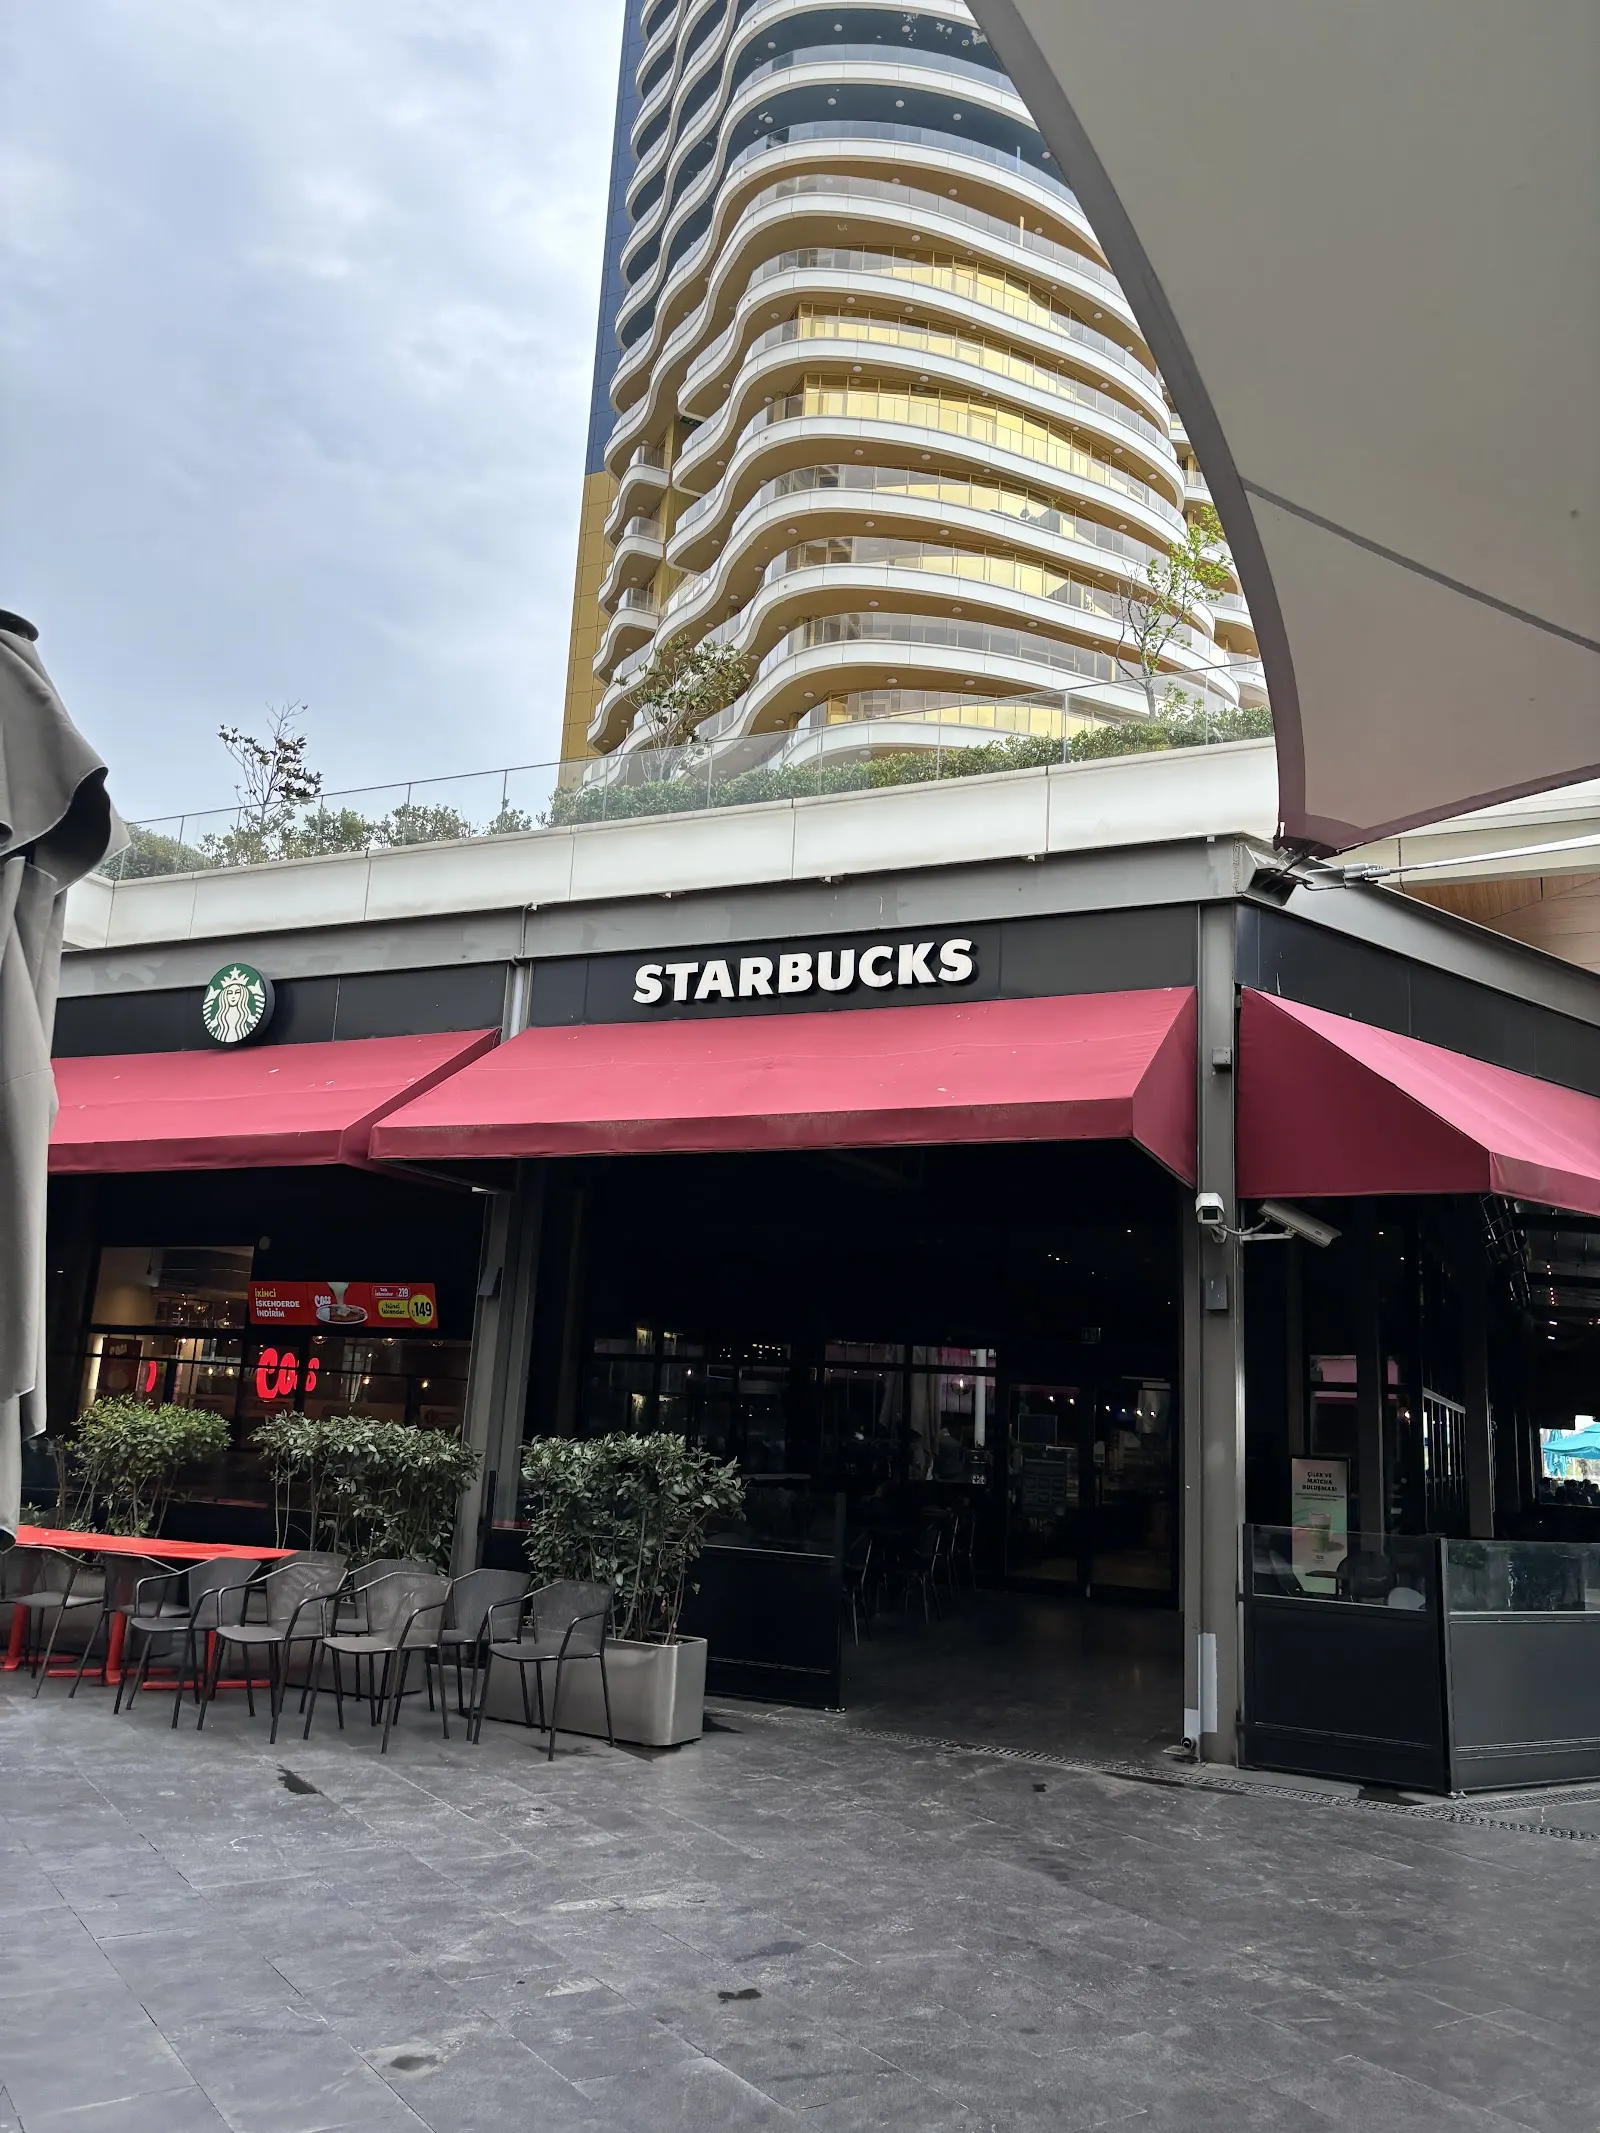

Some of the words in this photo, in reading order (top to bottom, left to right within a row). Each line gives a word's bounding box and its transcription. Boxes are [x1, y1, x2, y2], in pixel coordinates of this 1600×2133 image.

[633, 938, 973, 1004] STARBUCKS
[254, 1288, 276, 1297] İKİNCİ
[255, 1298, 300, 1308] İSKENDERDE
[256, 1308, 285, 1318] İNDİRİM
